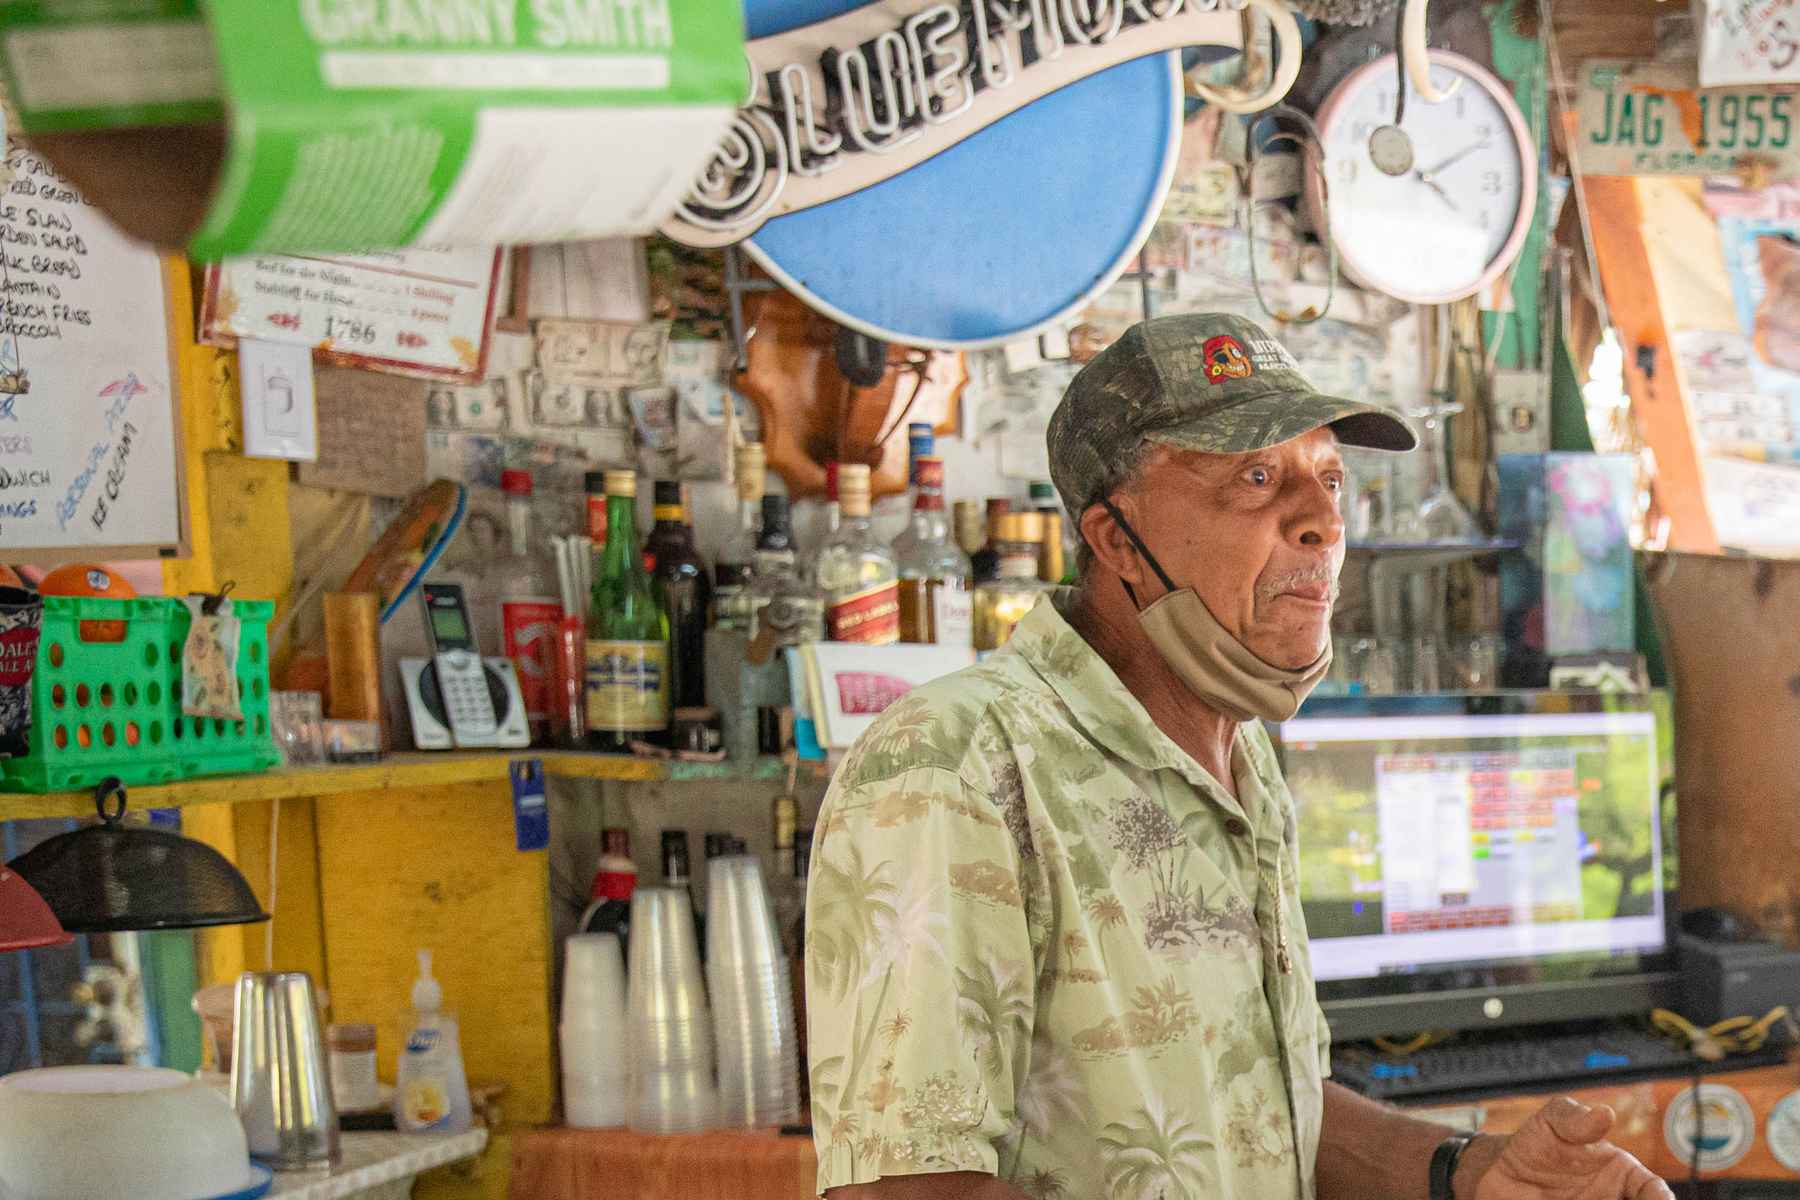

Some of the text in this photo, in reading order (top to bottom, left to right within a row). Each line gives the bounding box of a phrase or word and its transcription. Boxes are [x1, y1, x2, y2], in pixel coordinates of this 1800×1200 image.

[528, 0, 672, 48] SMITH
[1590, 88, 1793, 149] JAG 1955
